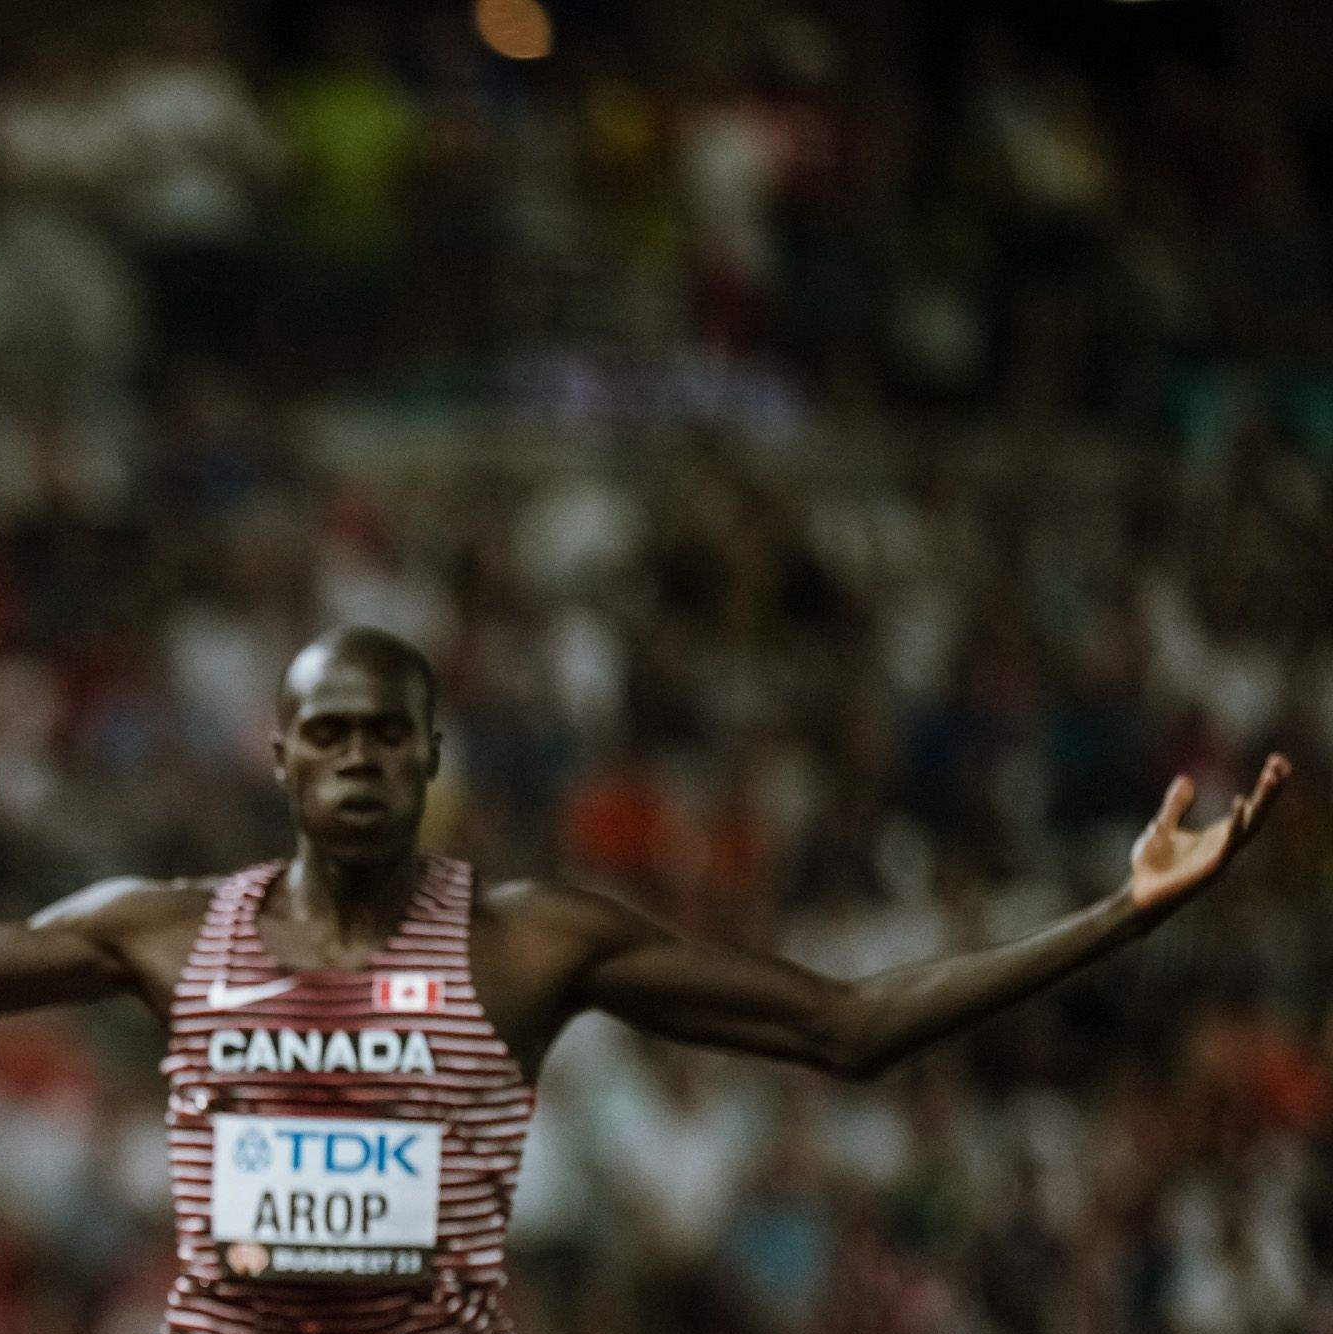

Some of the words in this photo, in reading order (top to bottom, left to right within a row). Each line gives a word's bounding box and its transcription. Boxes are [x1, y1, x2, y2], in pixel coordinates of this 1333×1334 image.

[209, 1029, 433, 1073] CANADA
[277, 1130, 420, 1177] TDK
[253, 1190, 389, 1238] AROP
